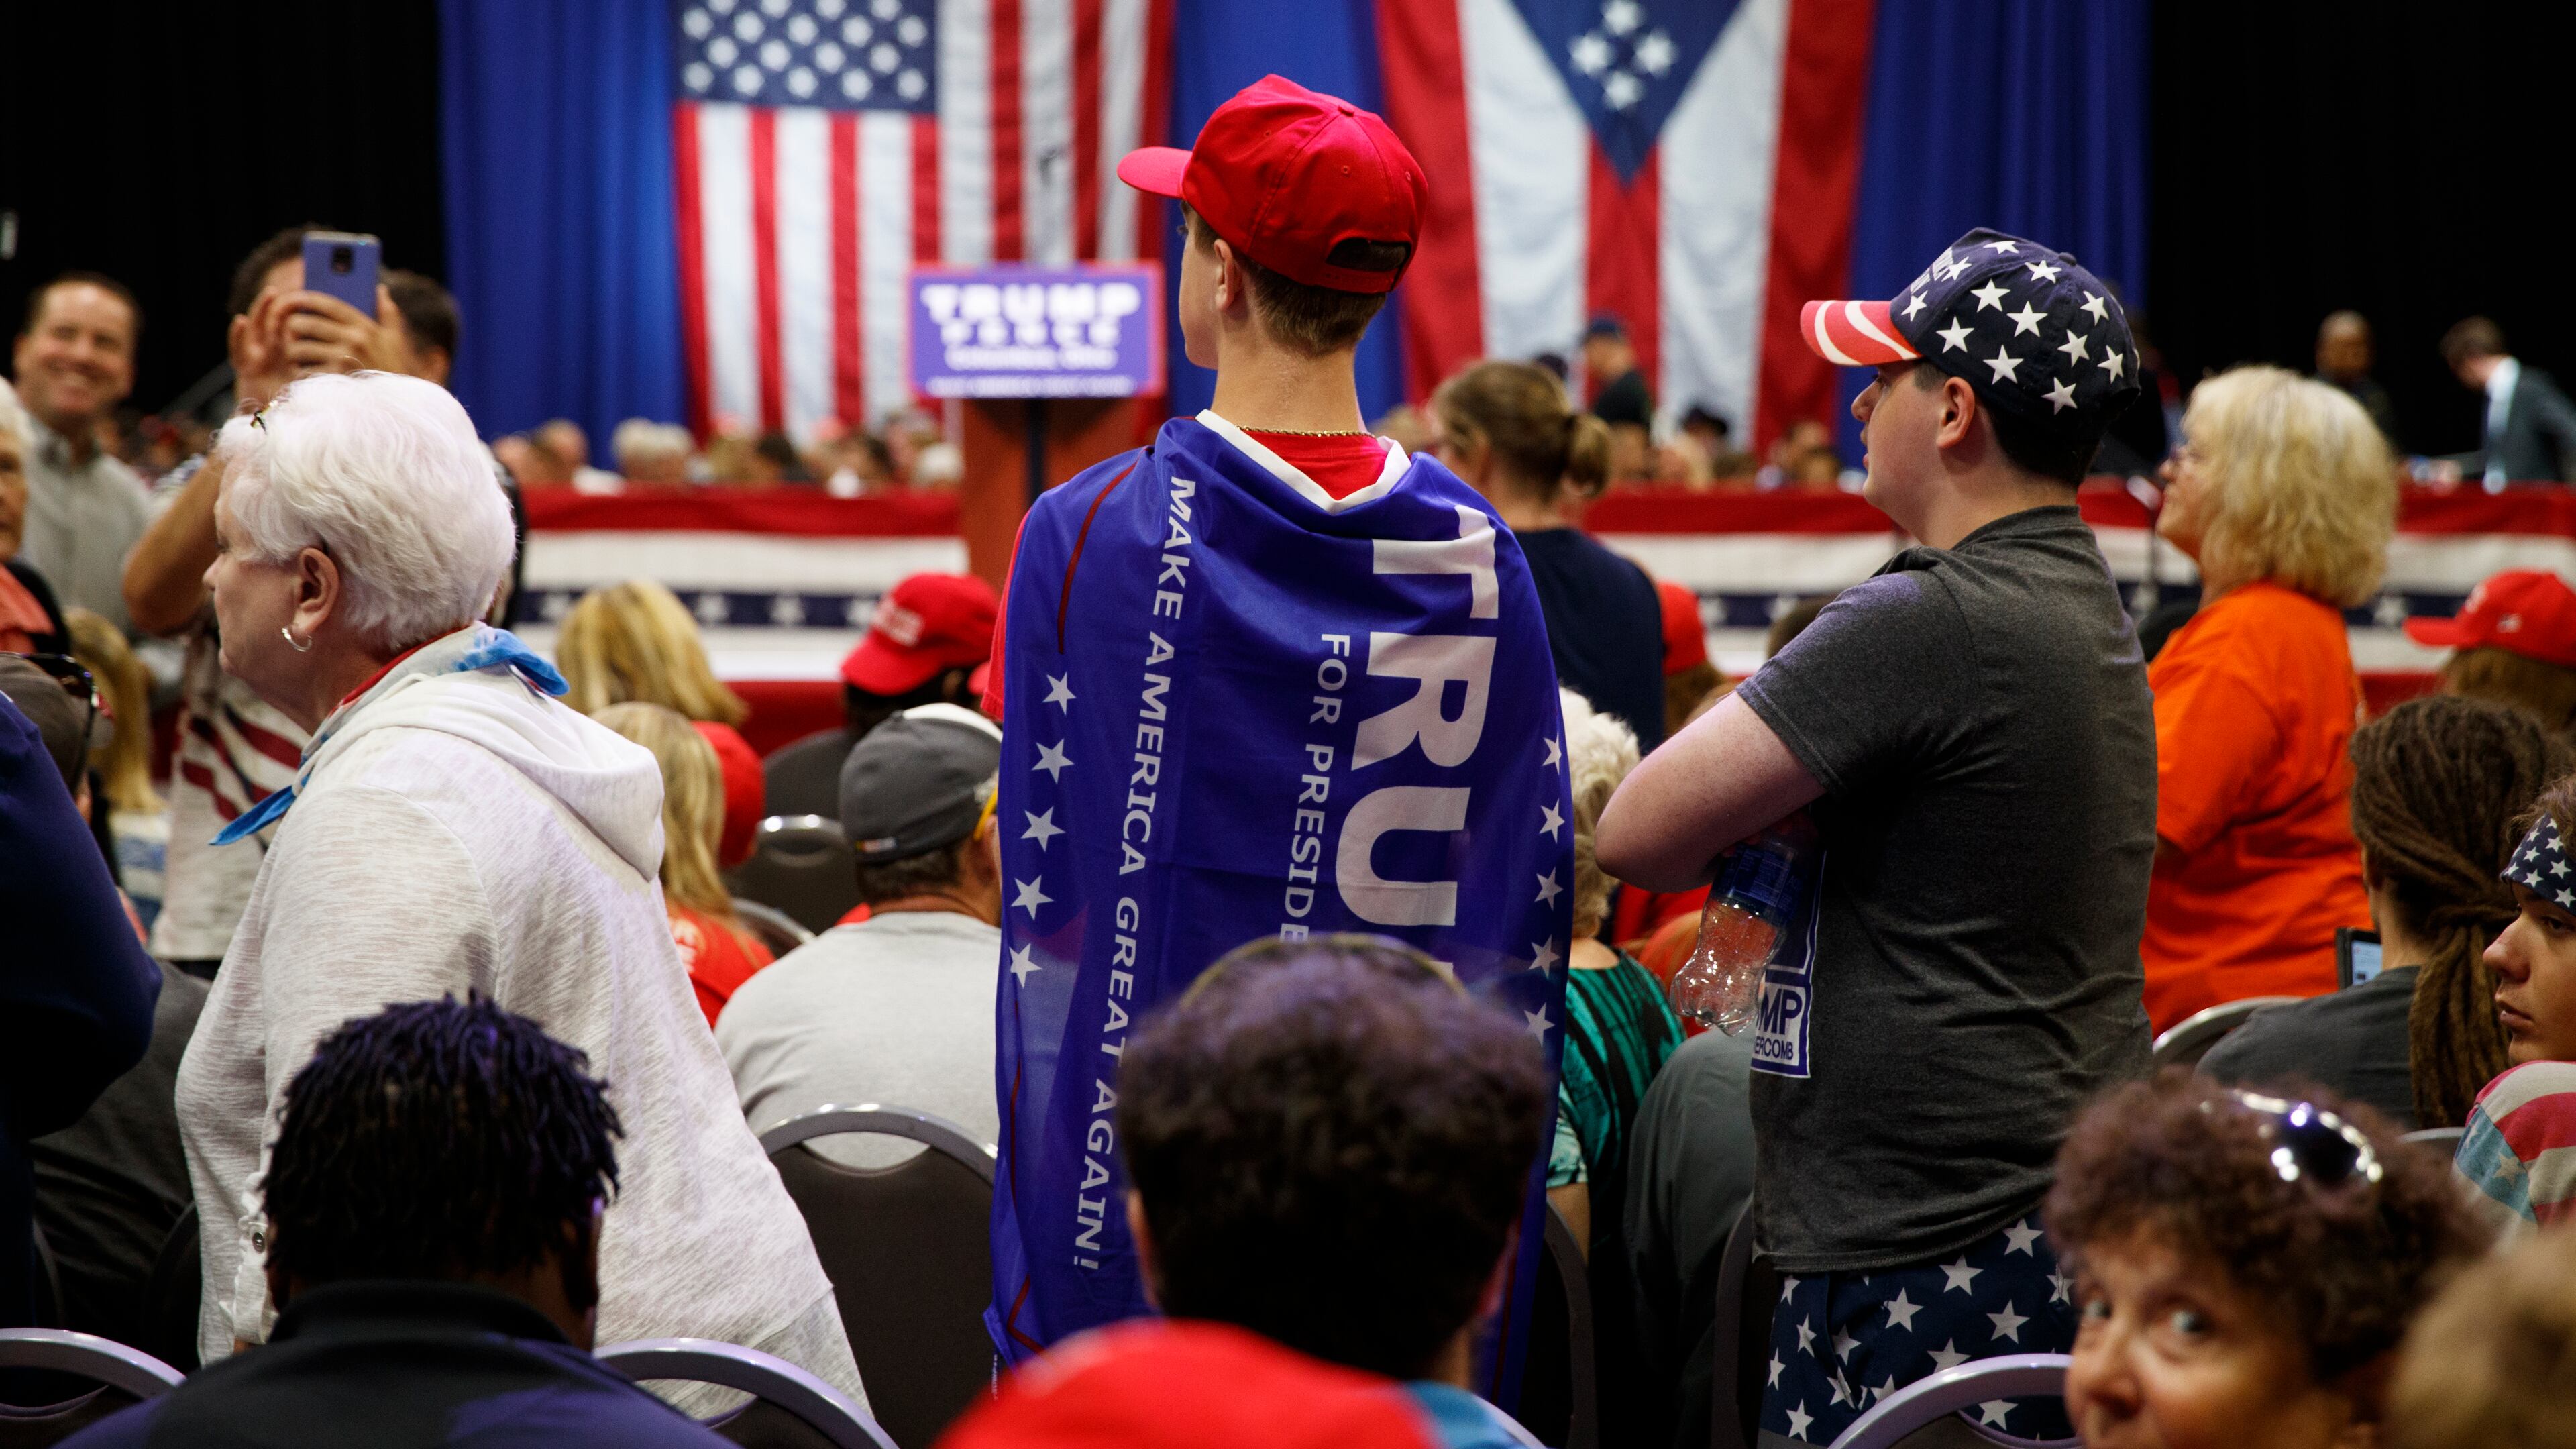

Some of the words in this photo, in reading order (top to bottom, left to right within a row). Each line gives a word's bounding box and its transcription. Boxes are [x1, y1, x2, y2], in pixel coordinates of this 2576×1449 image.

[1153, 476, 1196, 619] MAKE
[1119, 631, 1175, 875] AMERICA
[1309, 634, 1350, 724] FOR
[1336, 504, 1499, 981] TRU
[1101, 897, 1139, 1067] GREAT
[1756, 988, 1803, 1035] MP
[1074, 1079, 1118, 1270] AGAIN!
